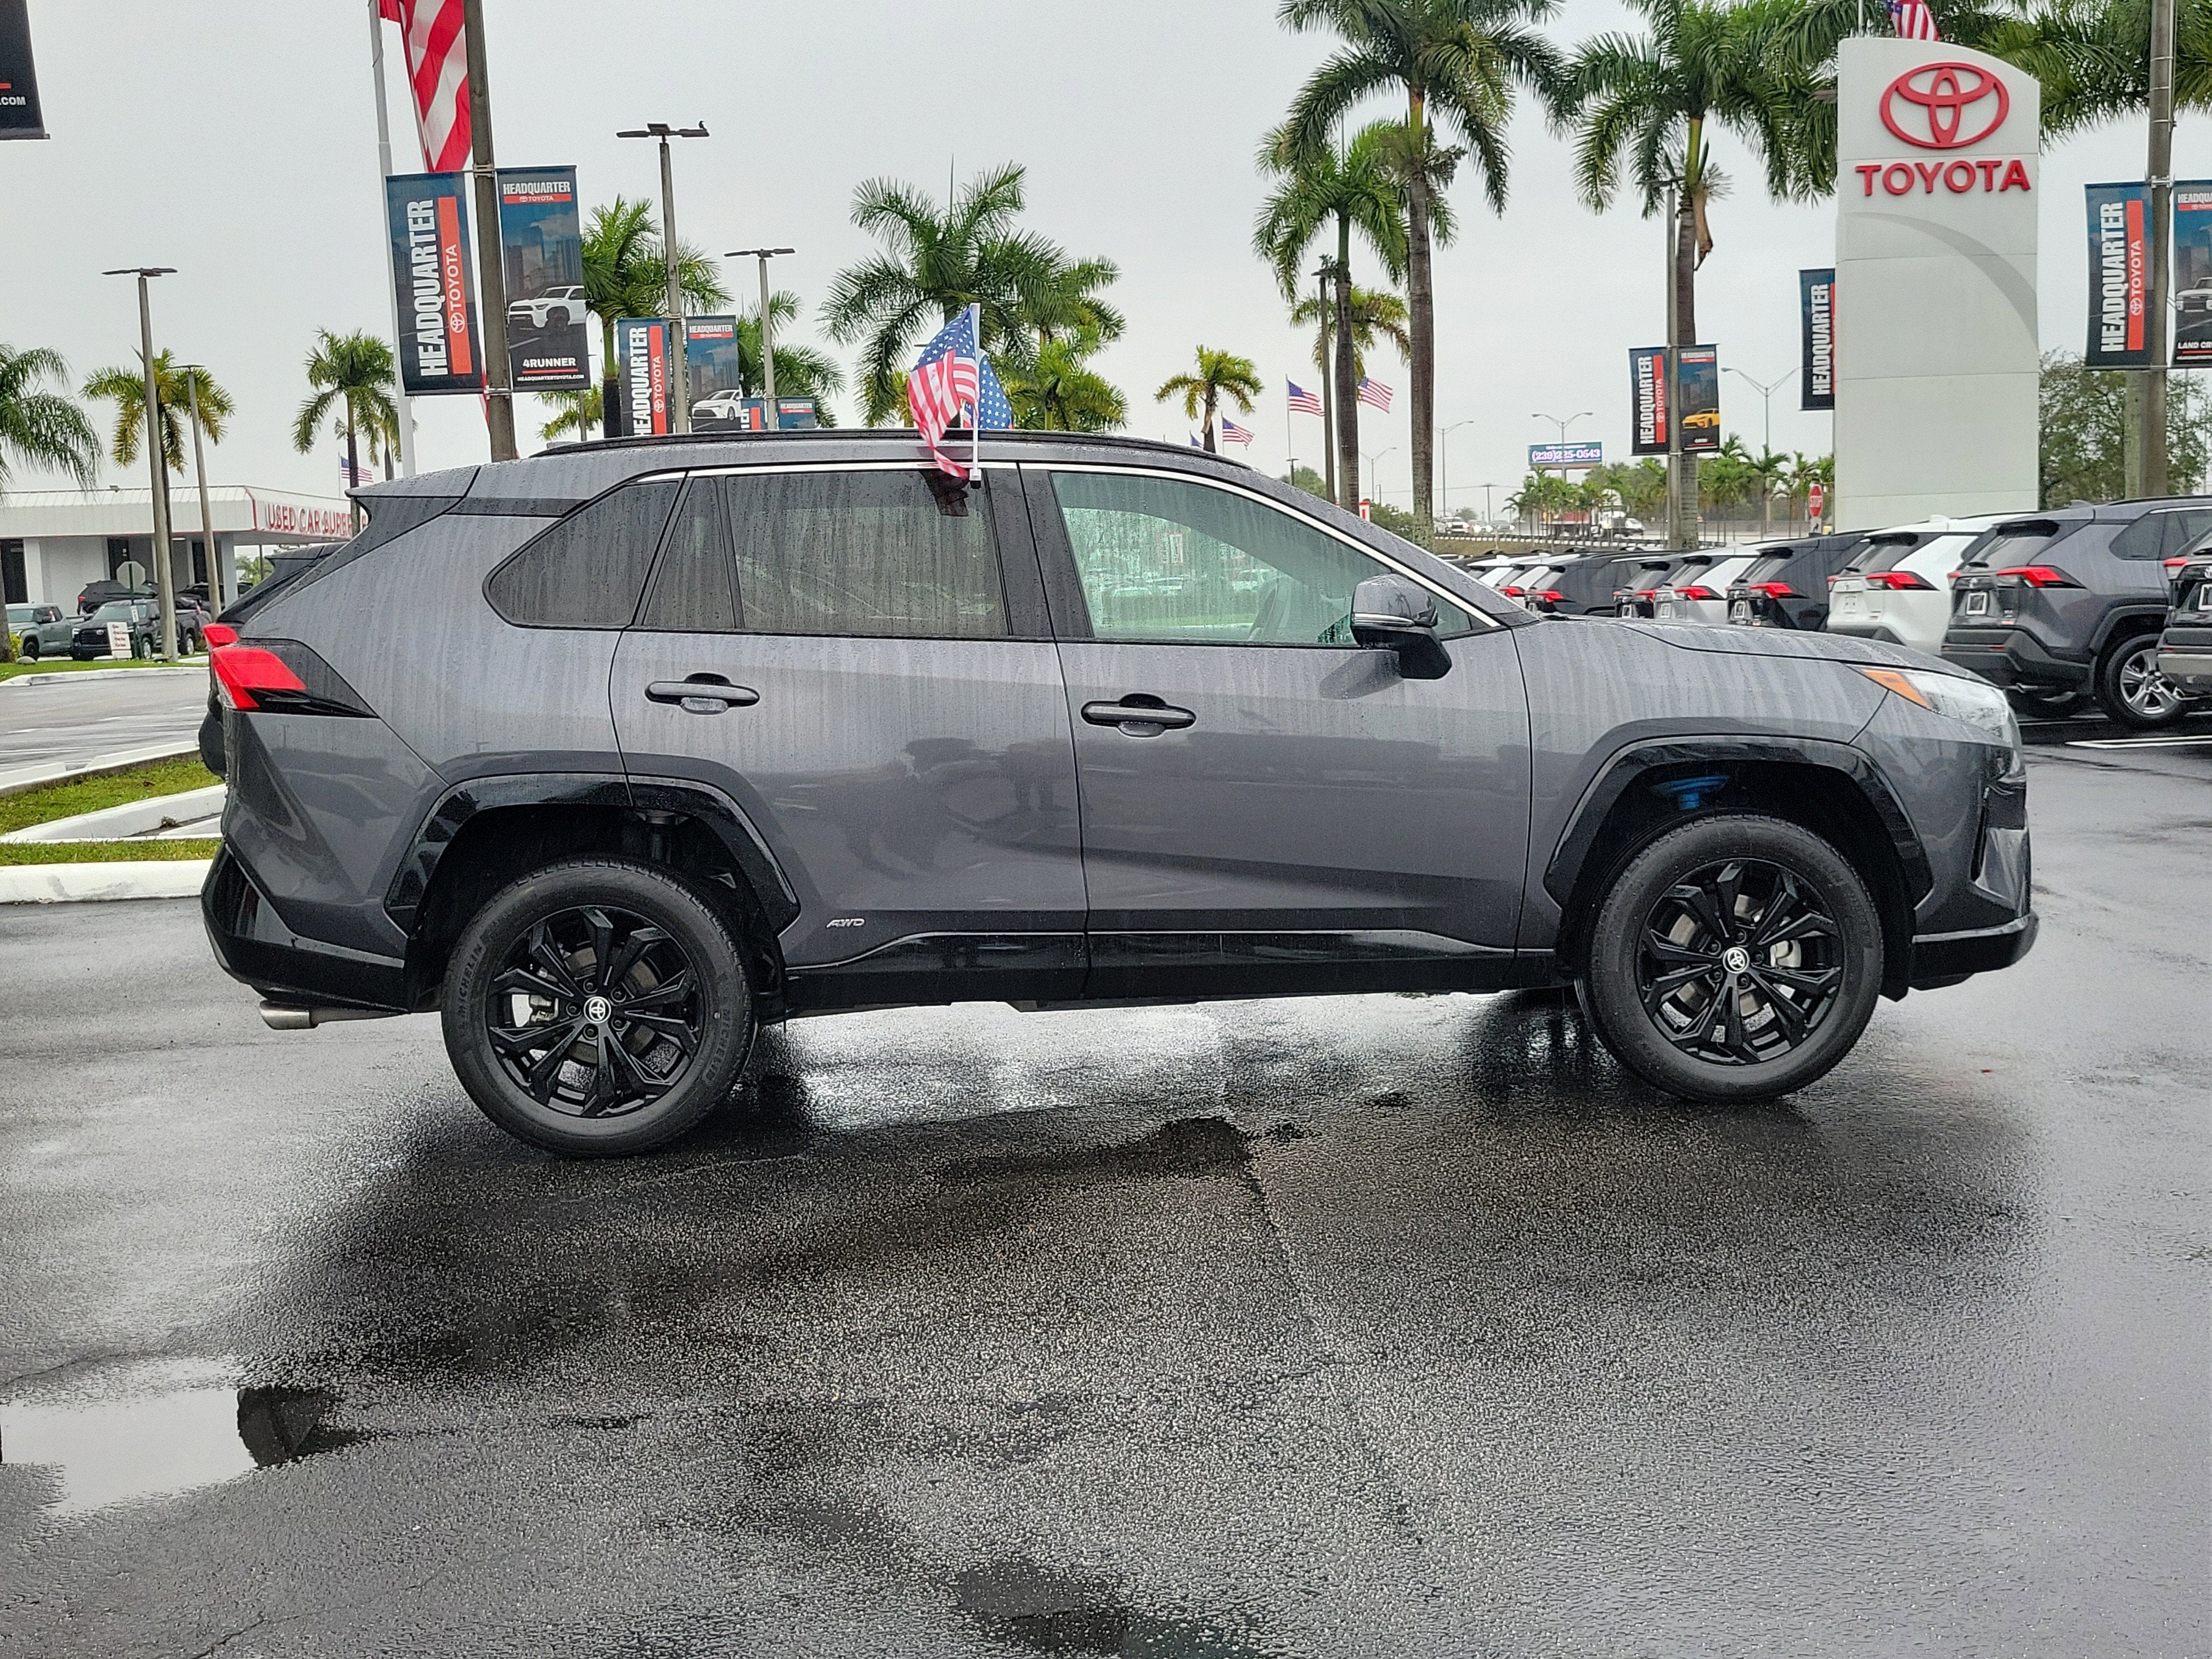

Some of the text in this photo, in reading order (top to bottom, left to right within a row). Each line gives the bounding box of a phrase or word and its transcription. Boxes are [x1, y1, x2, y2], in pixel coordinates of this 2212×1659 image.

[503, 182, 571, 195] HEADQUARTER
[1855, 160, 2031, 196] TOYOTA
[407, 199, 448, 376] HEADQUARTER
[446, 244, 462, 311] TOYOTA
[2100, 202, 2129, 352] HEADQUARTER
[2131, 240, 2142, 297] TOYOTA
[522, 357, 576, 368] 4RUNNER
[1811, 284, 1832, 396] HEADQUARTER
[629, 326, 652, 436] HEADQUARTER
[653, 356, 663, 399] TOYOTA
[1638, 356, 1655, 444] HEADQUARTER
[1656, 379, 1664, 412] TOYOTA
[267, 504, 296, 531] USED
[300, 508, 320, 534] CAR
[826, 918, 865, 928] AWD
